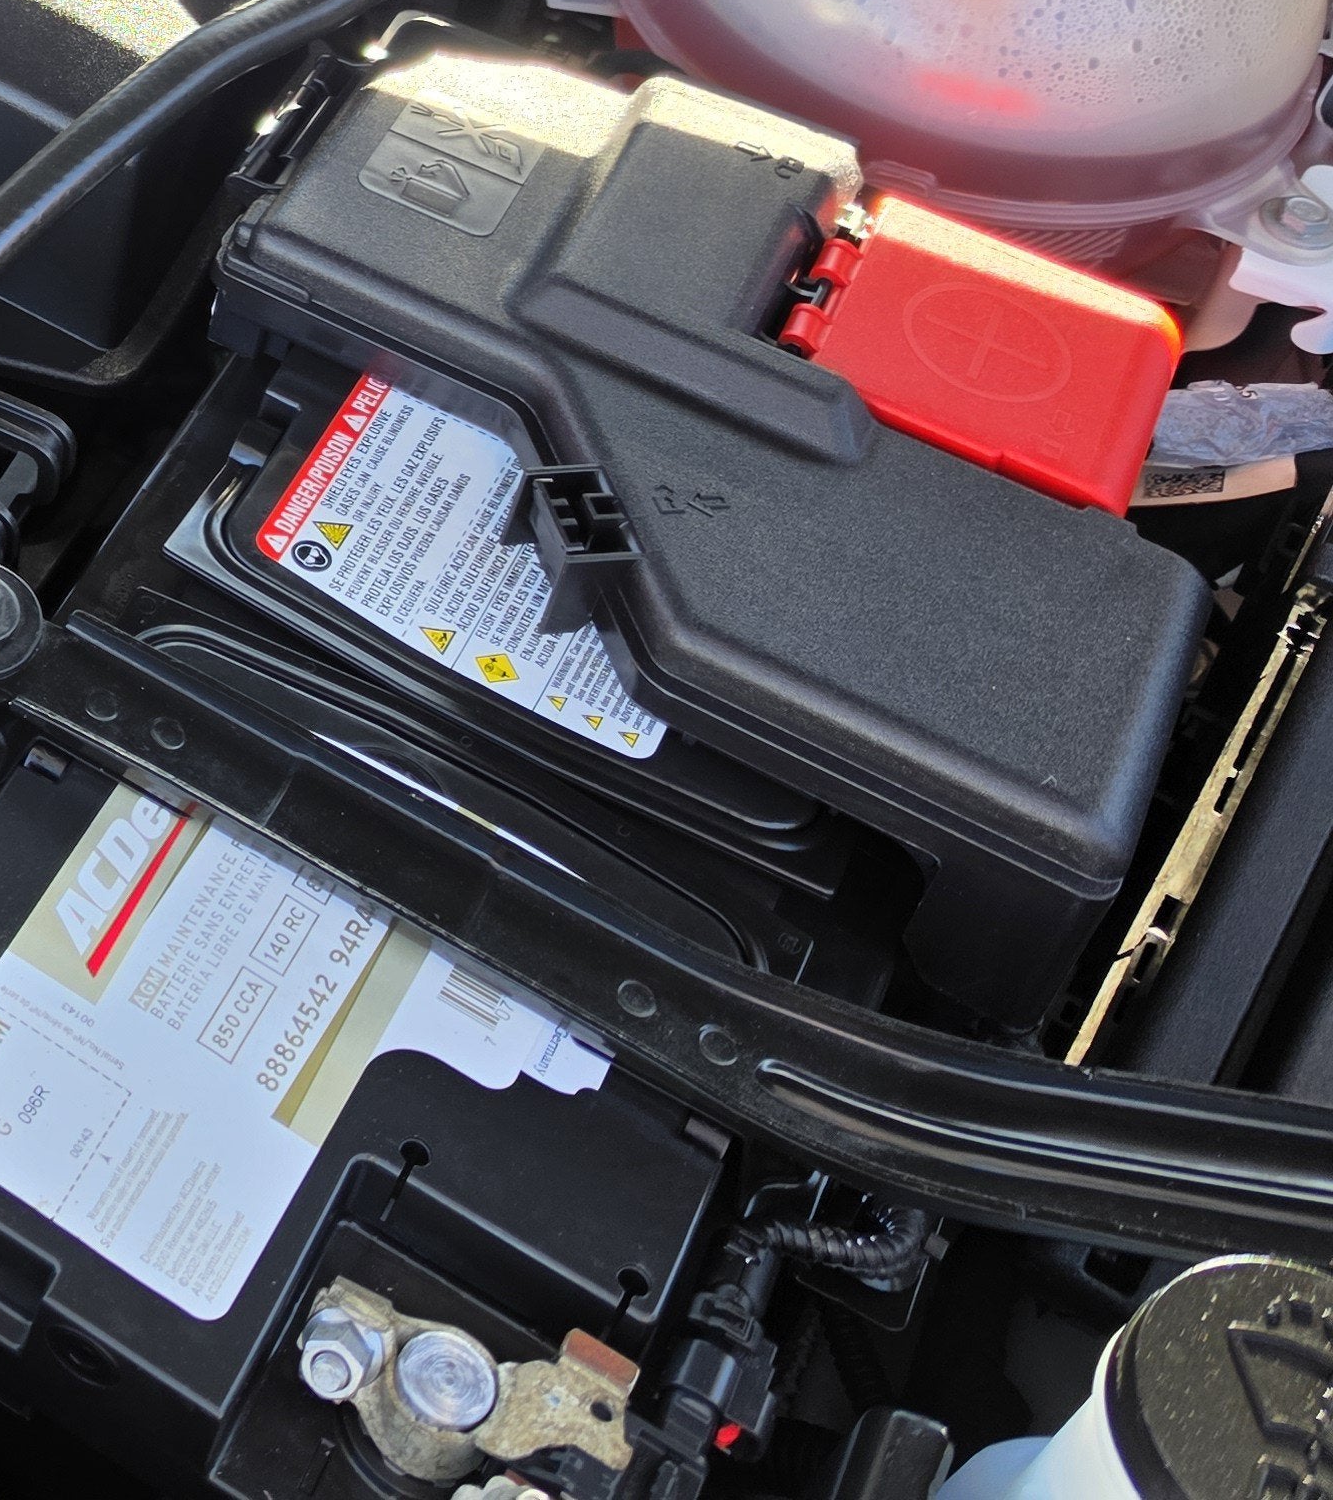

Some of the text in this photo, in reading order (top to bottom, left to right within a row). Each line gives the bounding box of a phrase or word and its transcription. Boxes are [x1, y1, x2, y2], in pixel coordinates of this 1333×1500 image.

[318, 476, 350, 512] SHIELD
[353, 406, 393, 456] EXPLOSIVE
[333, 401, 415, 519] GASES CAN CAUSE BLINDNESS
[409, 414, 446, 461] EXPLOSIFS
[272, 427, 355, 537] DANGER/POISON
[389, 473, 410, 494] LES
[399, 456, 420, 478] GAZ
[350, 508, 368, 525] OR
[386, 515, 404, 531] OU
[394, 484, 423, 519] RENDRE
[358, 565, 394, 609] PROTEJA
[383, 547, 405, 570] LOS
[411, 503, 433, 525] LOS
[422, 474, 451, 507] GASES
[362, 515, 384, 537] LES
[365, 527, 396, 566] BLESSER
[420, 568, 458, 616] SULFURIC
[446, 547, 471, 574] ACID
[459, 531, 481, 553] CAN
[470, 506, 497, 536] CAUSE
[485, 467, 521, 512] BLINDNESS
[343, 561, 375, 601] PEUVENT
[374, 559, 418, 617] EXPLOSIVOS
[408, 529, 437, 564] PUEDEN
[427, 498, 457, 533] CAUSAR
[457, 534, 502, 592] SULFURIQUE
[521, 567, 544, 592] YEUX
[327, 576, 346, 593] SE
[511, 587, 532, 607] LES
[471, 610, 498, 640] FLUSH
[488, 588, 512, 613] EYES
[493, 602, 522, 636] RINSER
[501, 605, 540, 655] CONSULTER
[529, 592, 548, 610] UN
[486, 631, 504, 647] SE
[531, 636, 560, 669] ACUDA
[153, 850, 240, 971] MAINTENANCE
[260, 903, 308, 966] 140 RC
[146, 947, 202, 1021] BATTERIE
[190, 907, 227, 952] SANS
[161, 964, 213, 1032] BATERÍA
[203, 923, 240, 969] LIBRE
[230, 900, 255, 927] DE
[209, 975, 264, 1051] 850 CCA
[255, 972, 340, 1094] 88864542
[13, 1082, 53, 1126] 096R
